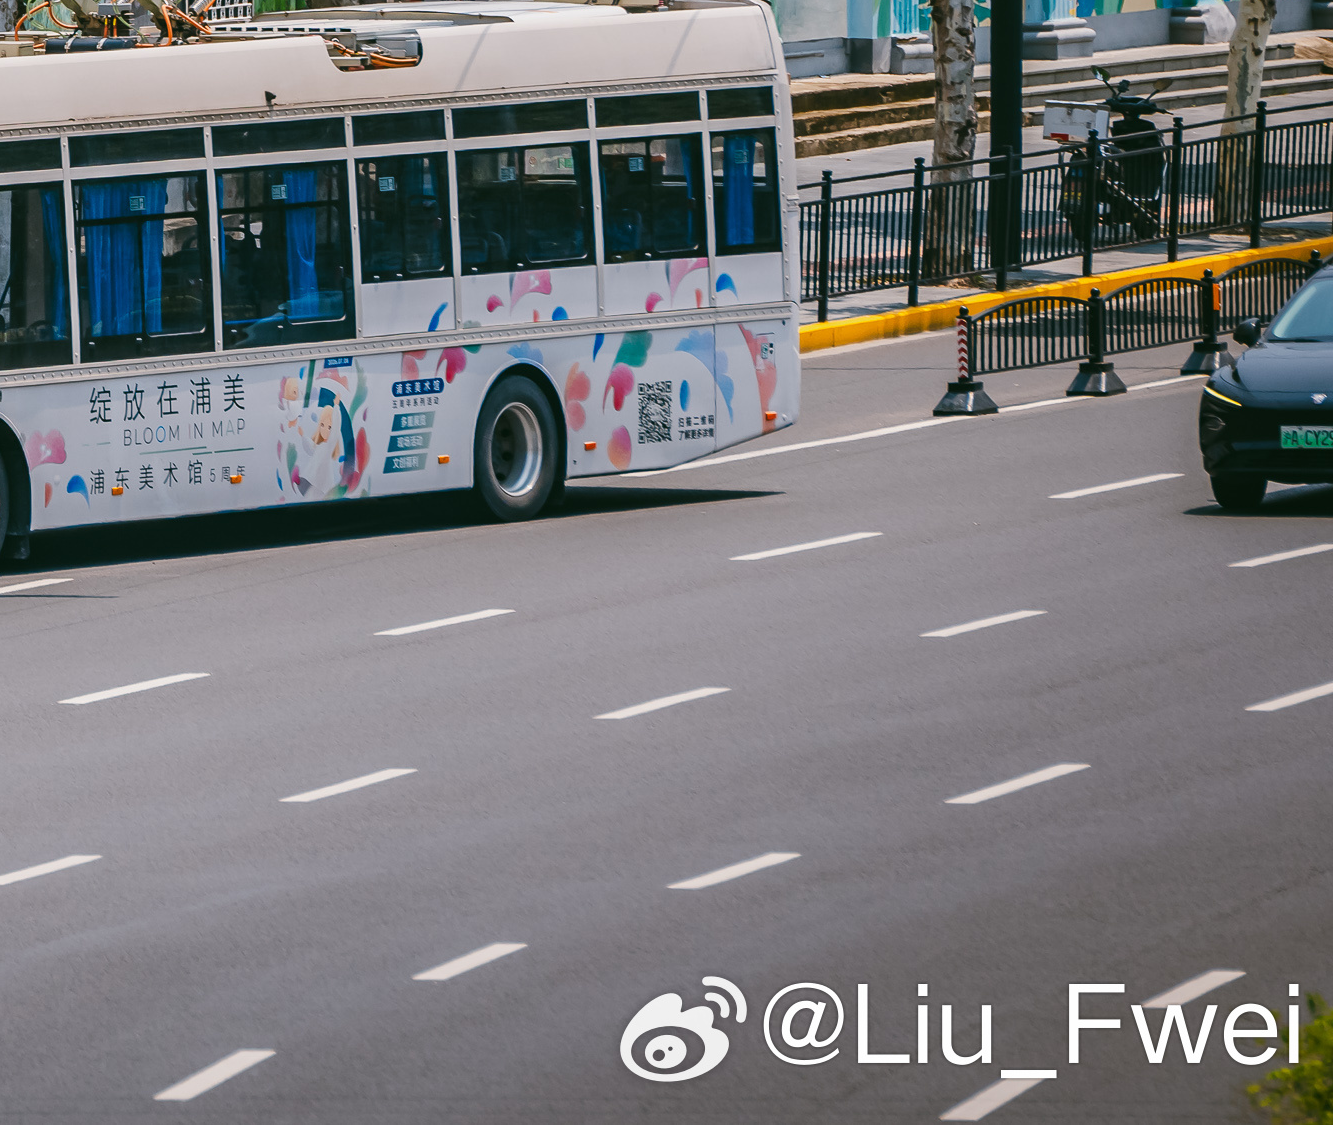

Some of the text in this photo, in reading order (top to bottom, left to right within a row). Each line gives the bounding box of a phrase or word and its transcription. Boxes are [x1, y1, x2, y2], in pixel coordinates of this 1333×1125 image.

[89, 373, 246, 425] 绽放在浦美
[123, 418, 247, 447] BLOOM IN MAP
[90, 459, 204, 495] 浦东美术馆
